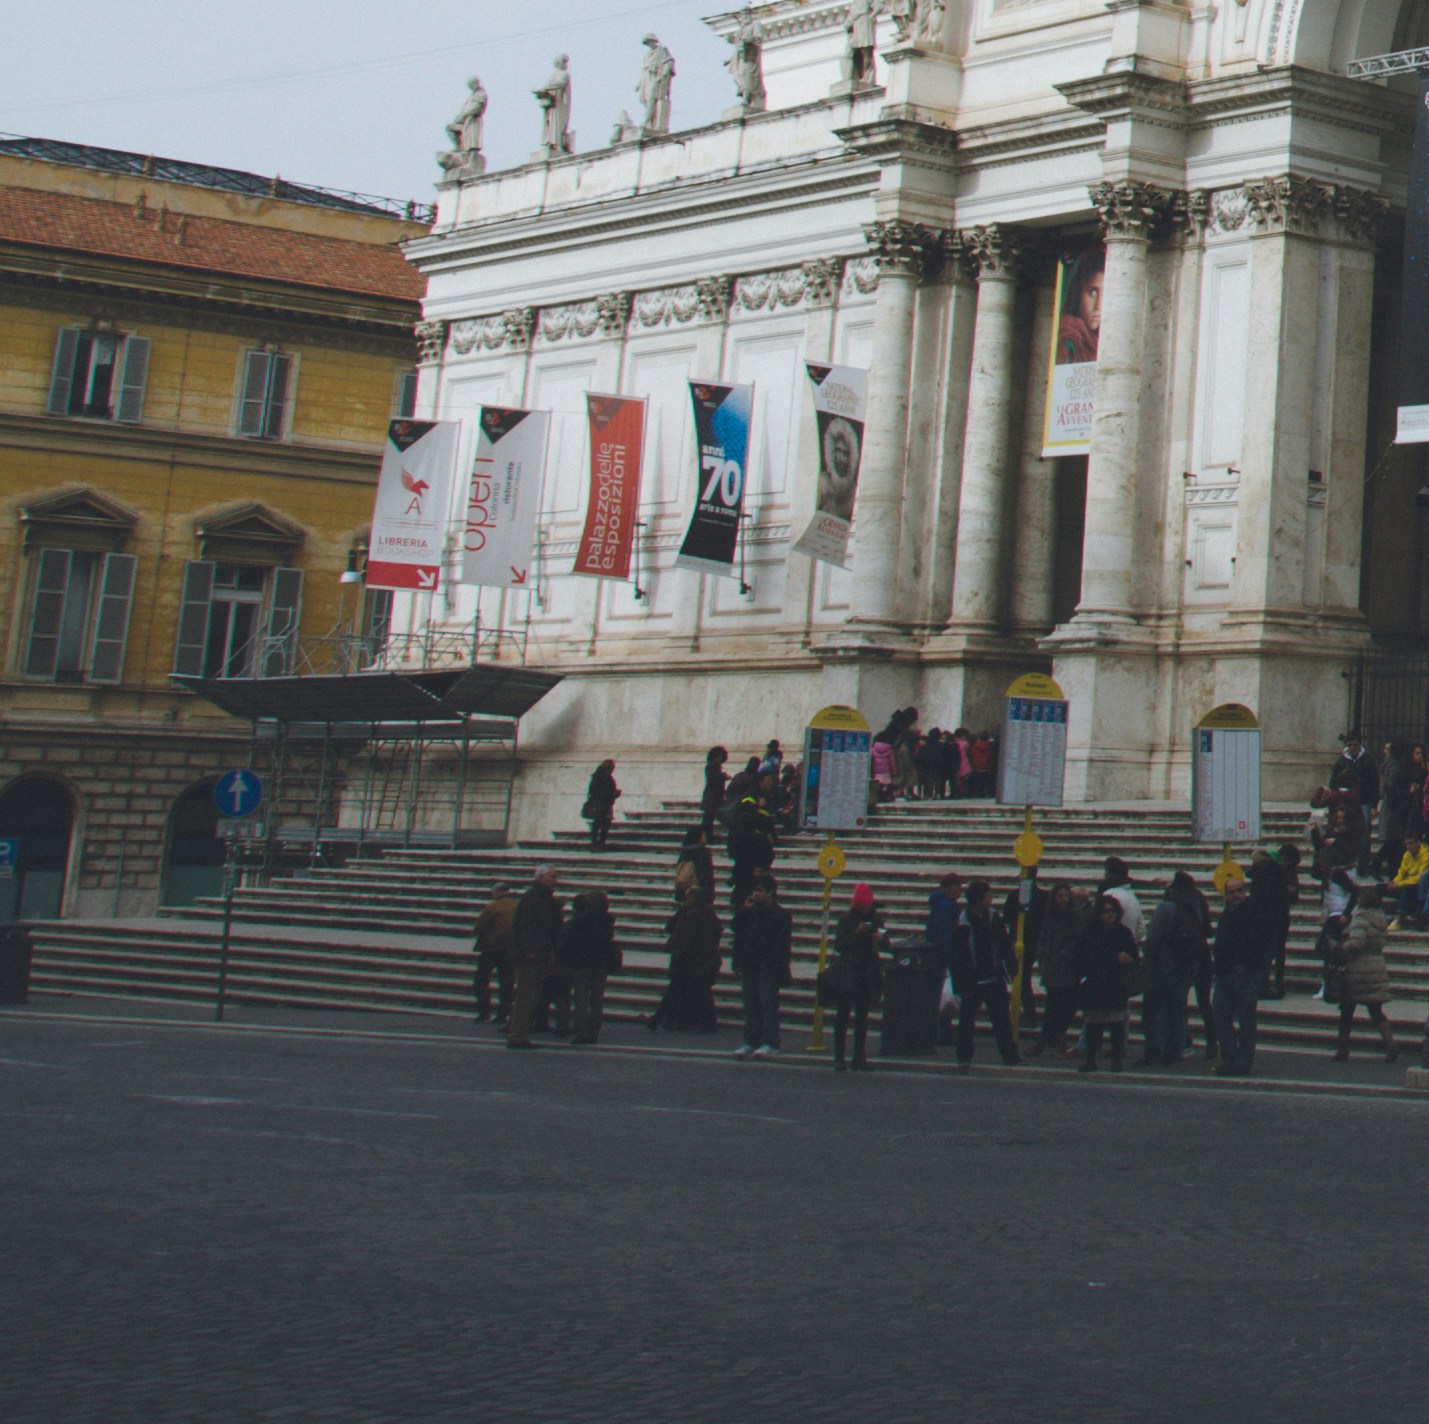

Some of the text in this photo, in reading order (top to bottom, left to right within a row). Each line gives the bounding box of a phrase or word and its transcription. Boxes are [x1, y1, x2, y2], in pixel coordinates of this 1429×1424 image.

[1065, 402, 1094, 416] GRAN
[1056, 412, 1092, 426] AVVENT
[702, 444, 725, 458] anni
[701, 456, 742, 507] 70
[602, 444, 626, 569] esposizioni
[378, 535, 428, 548] LIBRERIA
